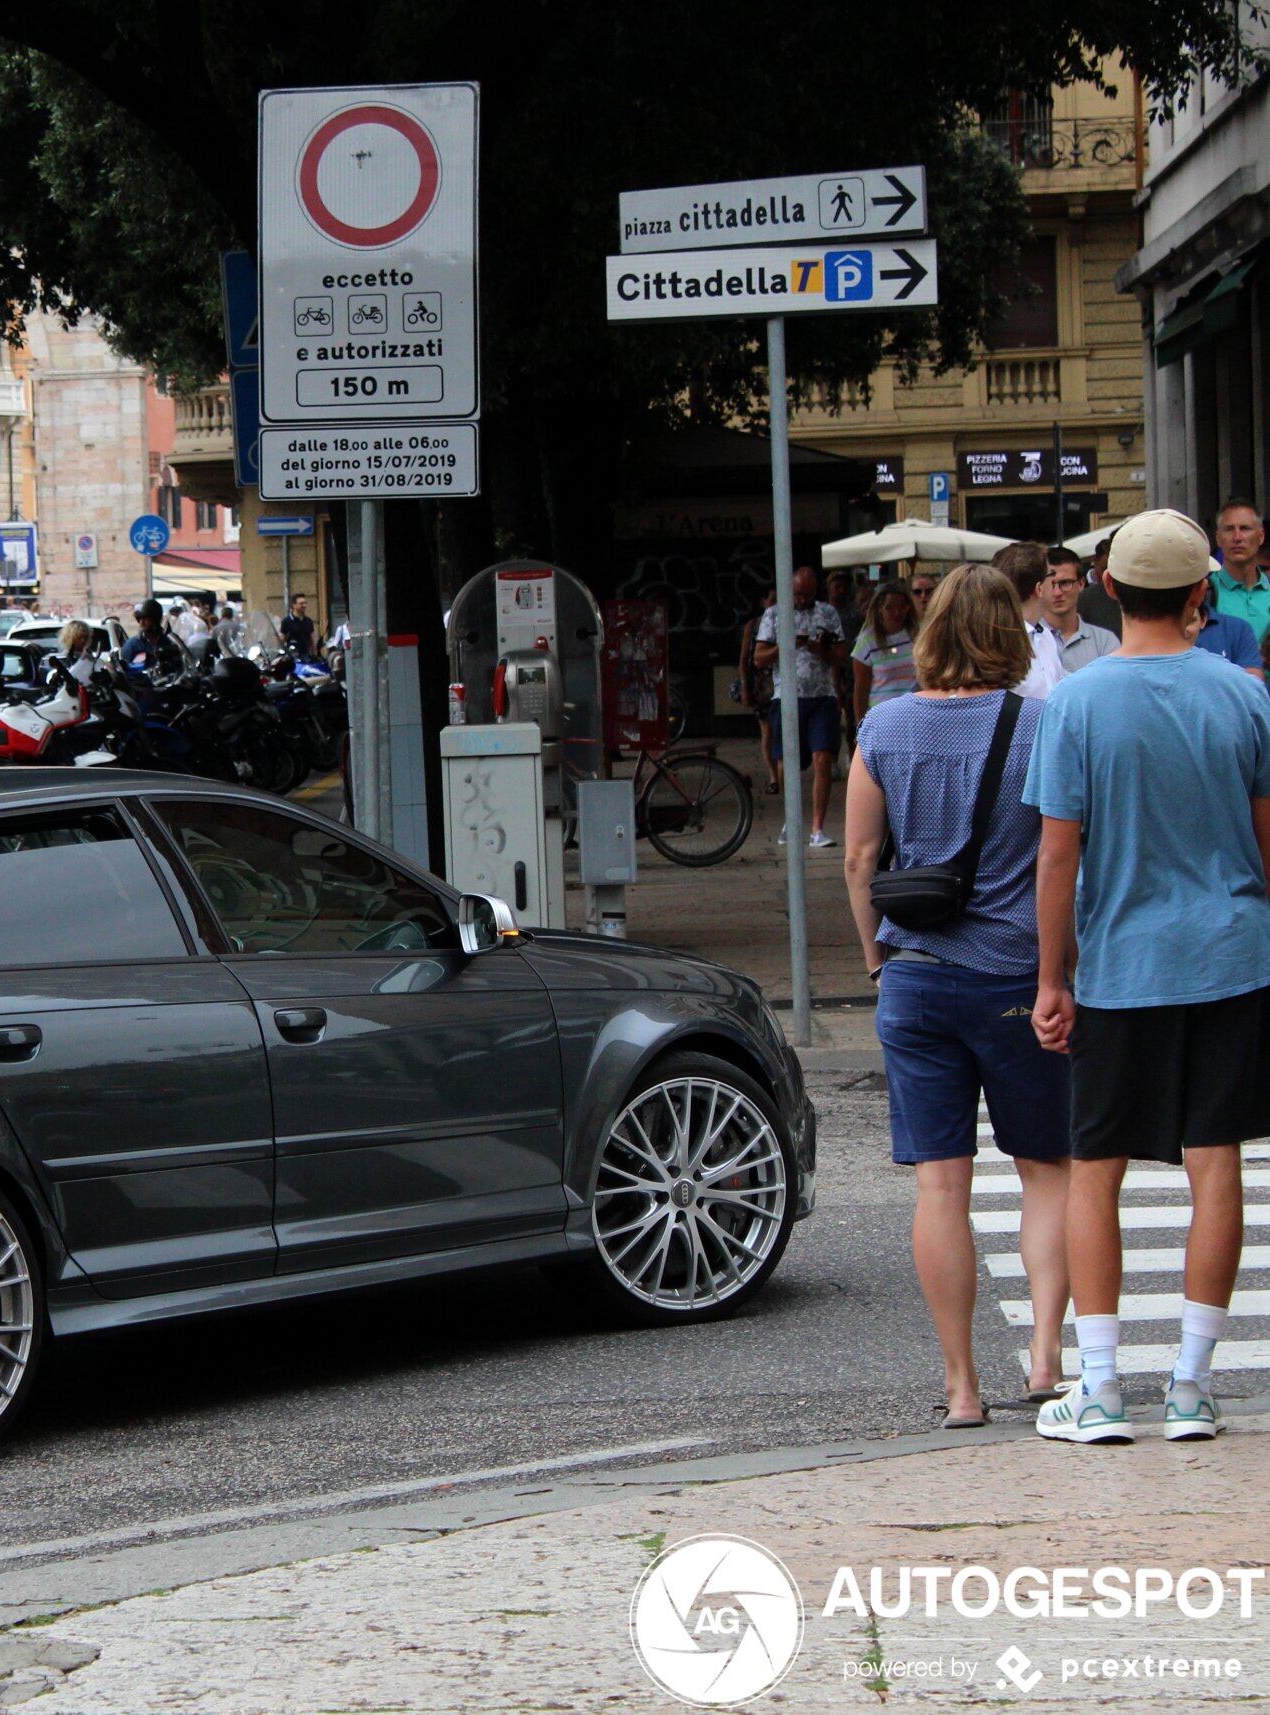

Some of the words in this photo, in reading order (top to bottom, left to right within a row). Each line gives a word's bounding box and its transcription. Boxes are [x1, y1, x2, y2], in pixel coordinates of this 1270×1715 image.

[625, 217, 671, 240] piazza
[679, 195, 806, 232] cittadella
[322, 269, 414, 289] eccetto
[617, 267, 788, 301] Cittadella
[837, 265, 862, 299] P
[296, 347, 309, 361] e
[316, 338, 443, 361] autorizzati
[331, 376, 378, 397] 150
[388, 379, 409, 396] m
[288, 439, 328, 452] dalle
[333, 438, 369, 451] 18.00
[373, 436, 404, 450] alle
[408, 436, 450, 450] 06.00
[281, 459, 306, 471] del
[310, 459, 361, 473] giorno
[366, 454, 457, 469] 15/07/2019
[966, 454, 1007, 464] PIZZERIA
[1061, 456, 1080, 466] CON
[972, 464, 1003, 474] FORNO
[285, 477, 300, 489] al
[305, 477, 355, 491] giorno
[360, 473, 453, 487] 31/08/2019
[933, 476, 945, 500] P
[972, 474, 1002, 484] LEGNA
